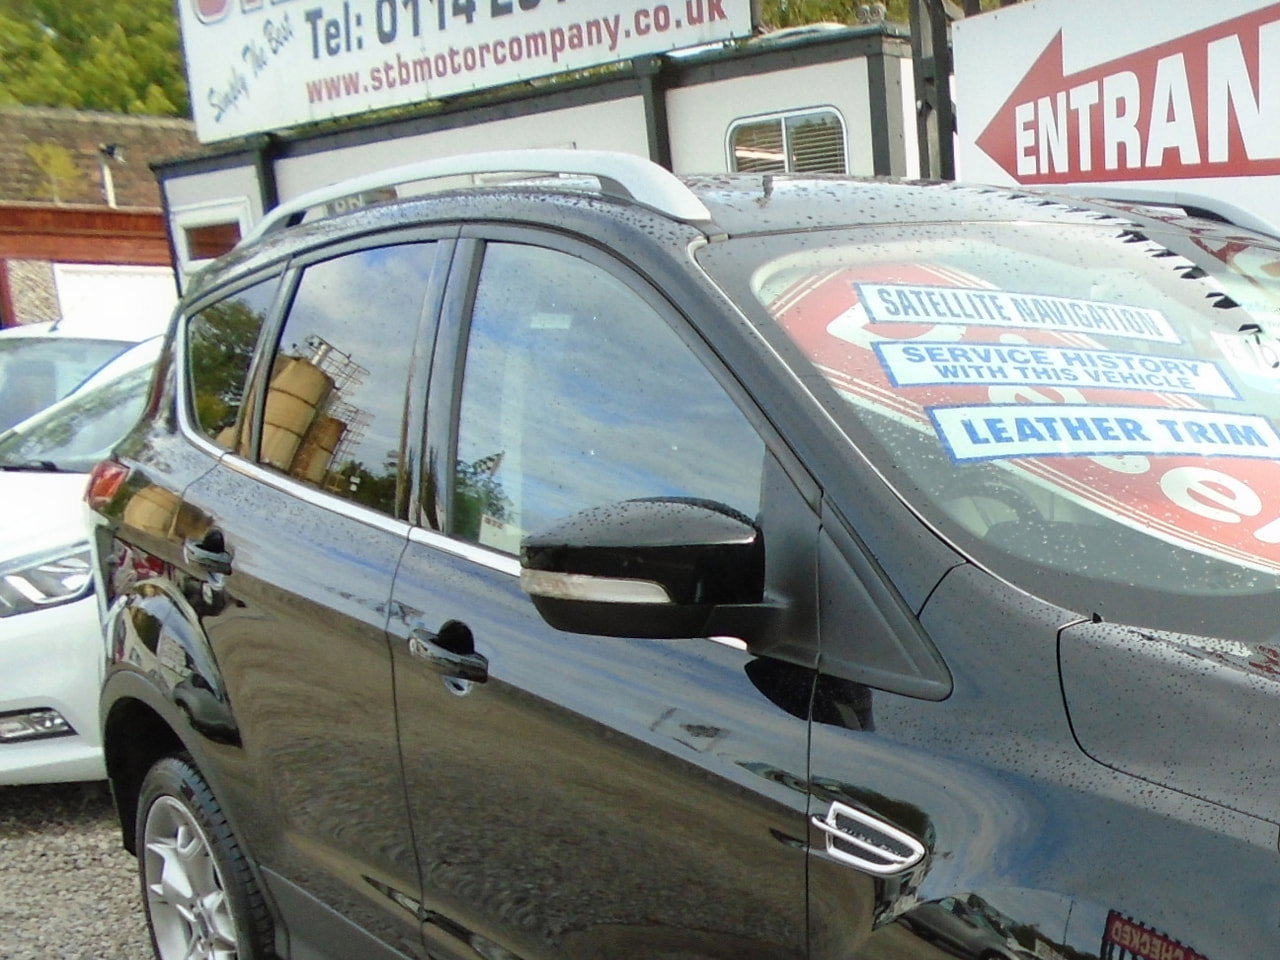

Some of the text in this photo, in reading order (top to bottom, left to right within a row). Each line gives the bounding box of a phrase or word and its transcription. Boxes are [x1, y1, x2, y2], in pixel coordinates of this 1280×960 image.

[304, 4, 364, 59] Tel:
[306, 0, 728, 103] www.stbmotorcompany.co.uk
[877, 287, 1163, 338] SATELLITE NAVIGATION
[903, 345, 1200, 378] SERVICE HISTORY
[936, 364, 1196, 390] WITH THIS VEHICLE
[961, 416, 1269, 448] LEATHER TRIM
